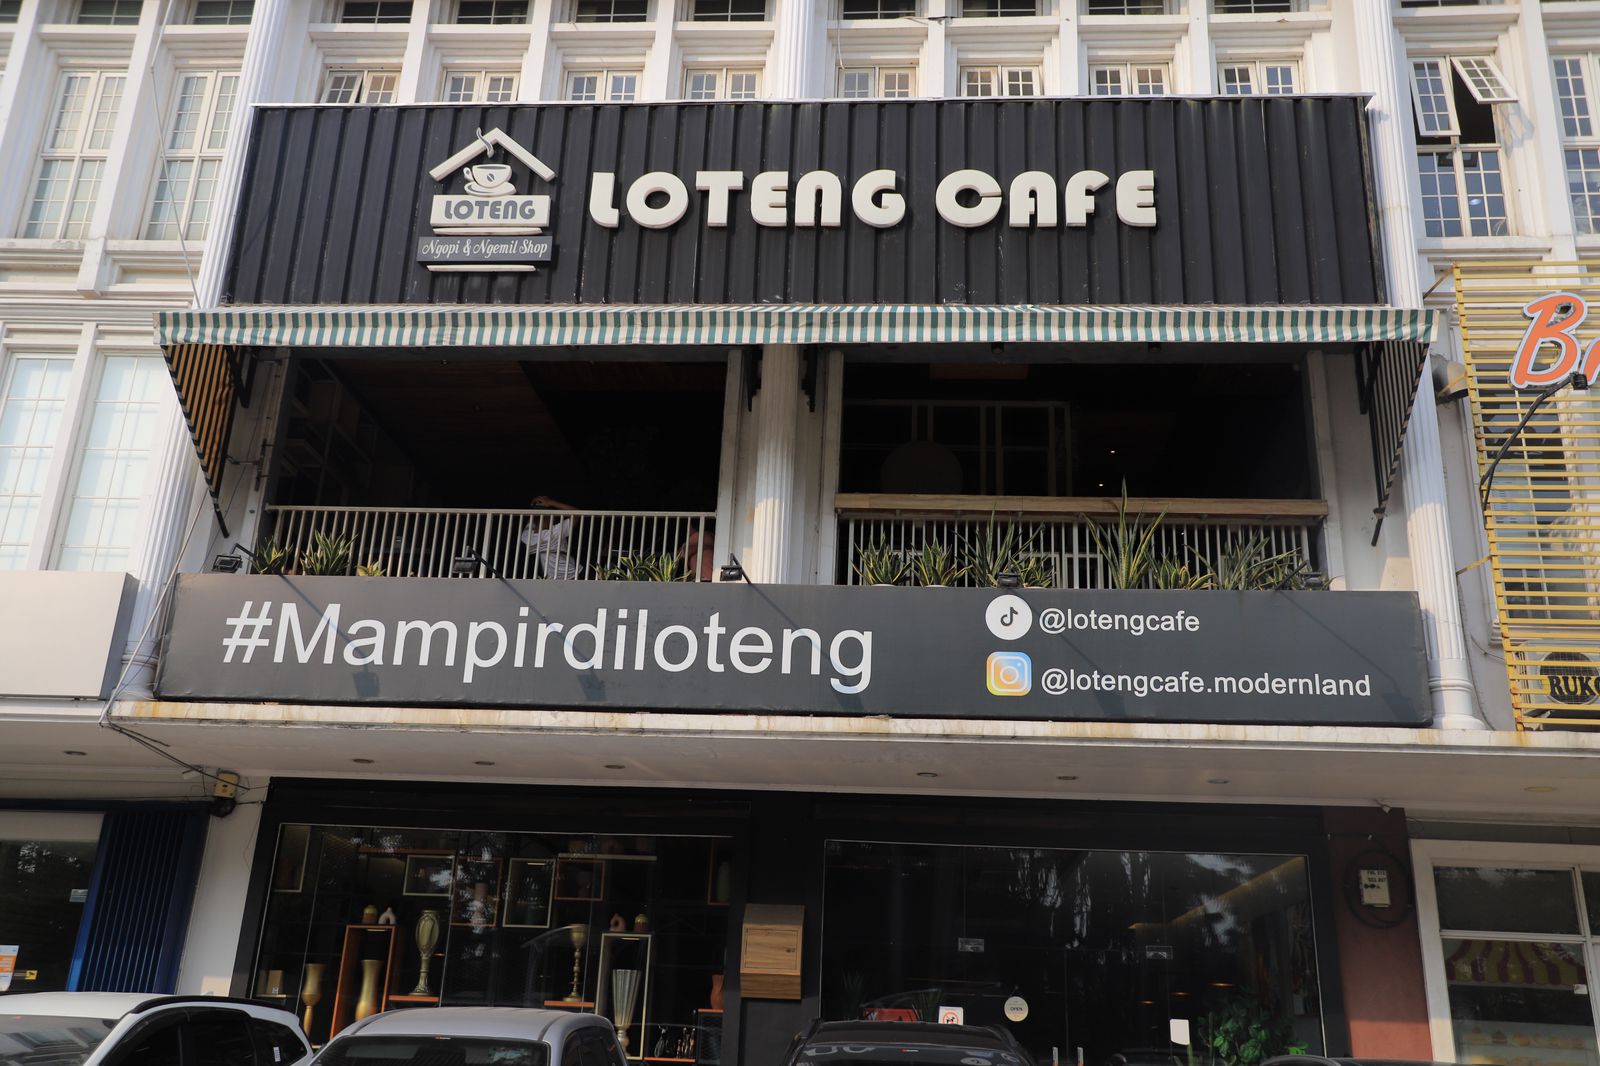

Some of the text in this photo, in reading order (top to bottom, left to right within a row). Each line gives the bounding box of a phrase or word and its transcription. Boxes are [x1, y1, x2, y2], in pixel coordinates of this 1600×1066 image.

[444, 200, 536, 220] LOTENG
[589, 169, 1157, 229] LOTENG CAFE
[422, 238, 548, 258] Ngopi & Ngemil Shop
[1039, 607, 1200, 636] @lotengcafe
[222, 600, 872, 694] #Mampirdiloteng
[1041, 667, 1372, 698] @lotengcafe.modernland
